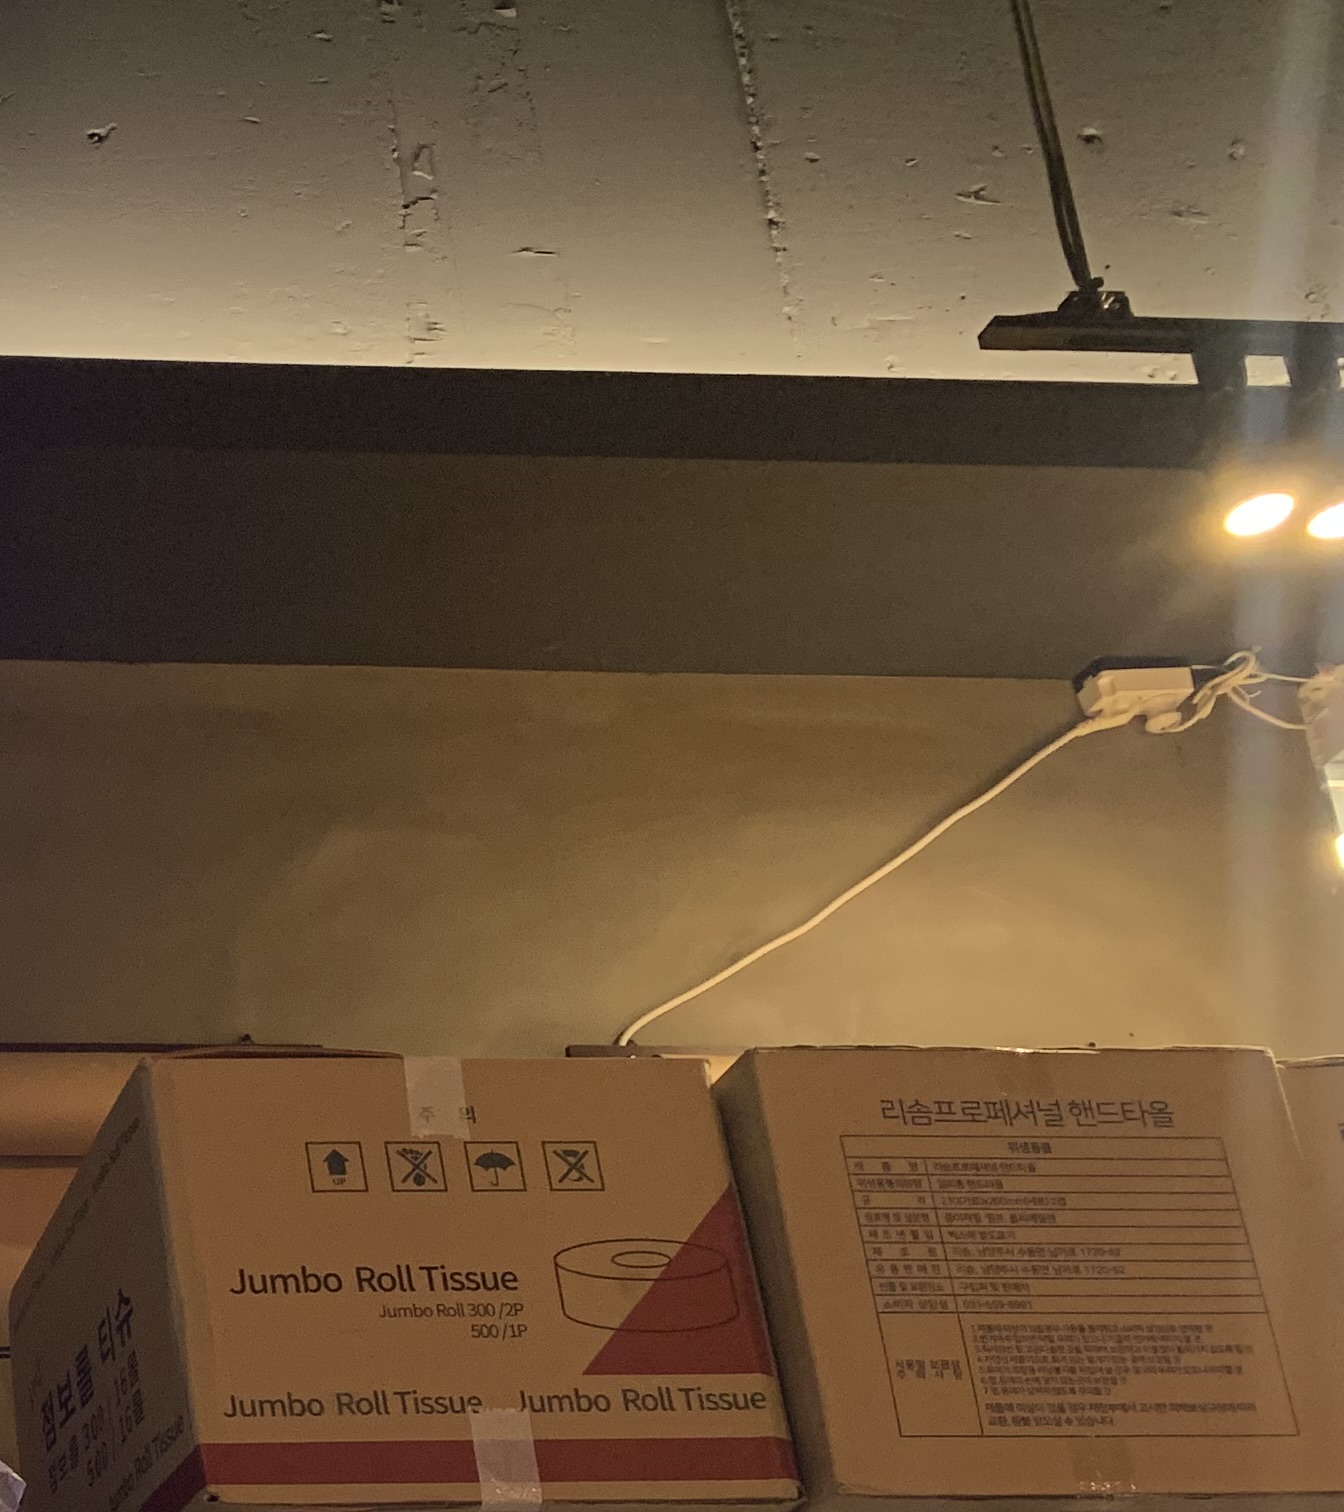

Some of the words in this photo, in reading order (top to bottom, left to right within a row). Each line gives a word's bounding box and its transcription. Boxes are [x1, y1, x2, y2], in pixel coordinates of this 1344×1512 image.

[1067, 1100, 1175, 1129] 핸드타올
[230, 1265, 343, 1295] Jumbo
[355, 1264, 416, 1293] Roll
[418, 1264, 519, 1292] Tissue
[378, 1302, 433, 1319] Jumbo
[436, 1302, 466, 1318] Roll
[468, 1303, 496, 1318] 300
[97, 1287, 133, 1365] 티슈
[471, 1323, 499, 1339] 500
[223, 1392, 324, 1418] Jumbo
[335, 1390, 390, 1416] Roll
[400, 1390, 484, 1415] Tissue
[518, 1388, 612, 1414] Jumbo
[620, 1387, 675, 1413] Roll
[684, 1386, 768, 1412] Tissue
